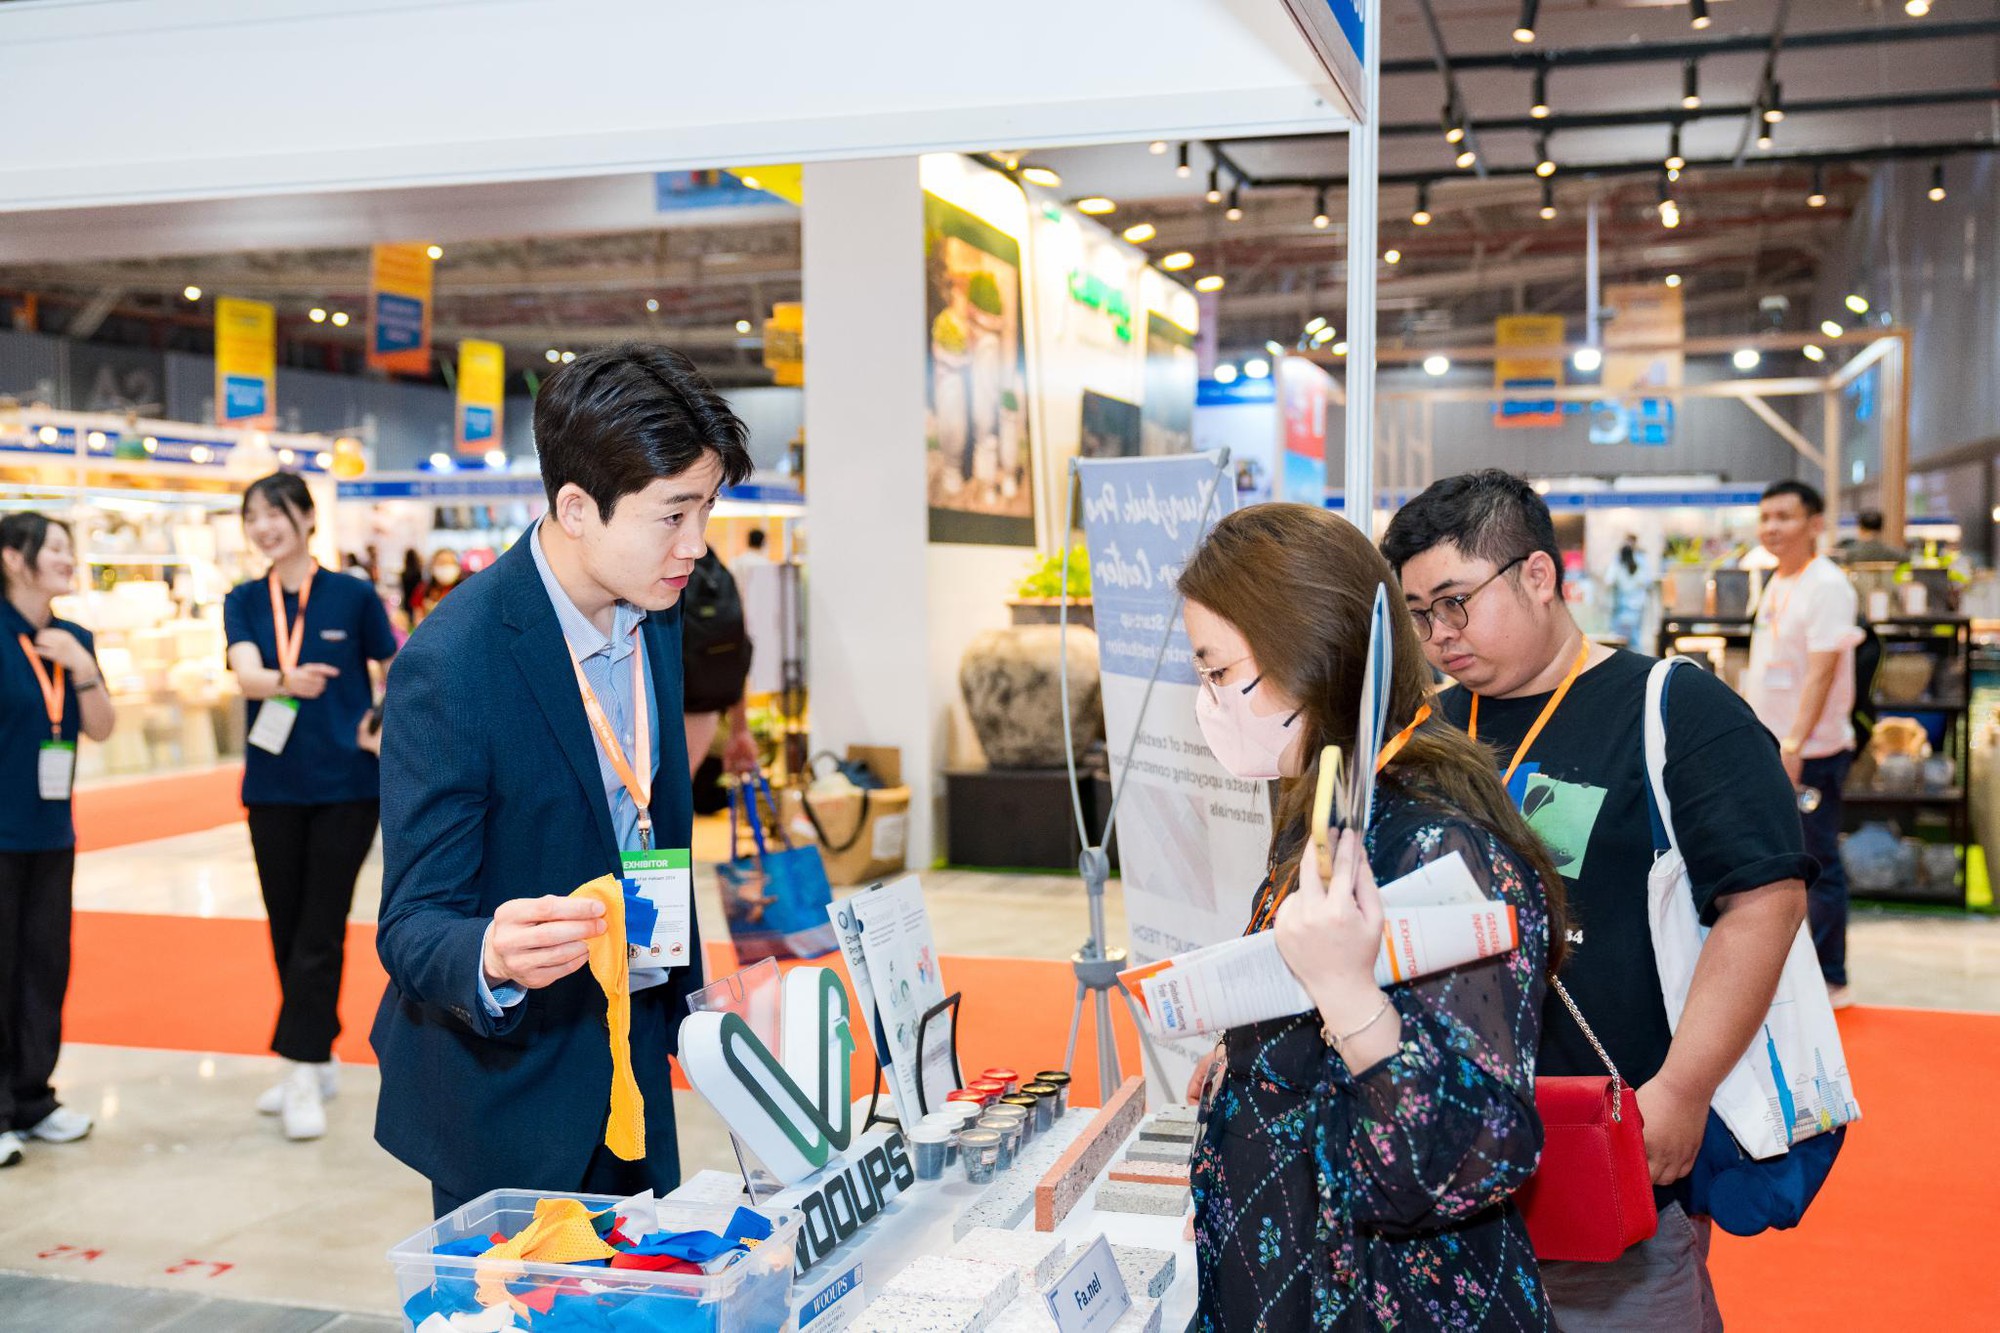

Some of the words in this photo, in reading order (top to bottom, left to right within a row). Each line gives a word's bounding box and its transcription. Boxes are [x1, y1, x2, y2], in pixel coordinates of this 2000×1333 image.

[622, 859, 669, 869] EXHIBITOR
[812, 1276, 849, 1315] WOOUPS
[1073, 1271, 1103, 1311] Fa.nel
